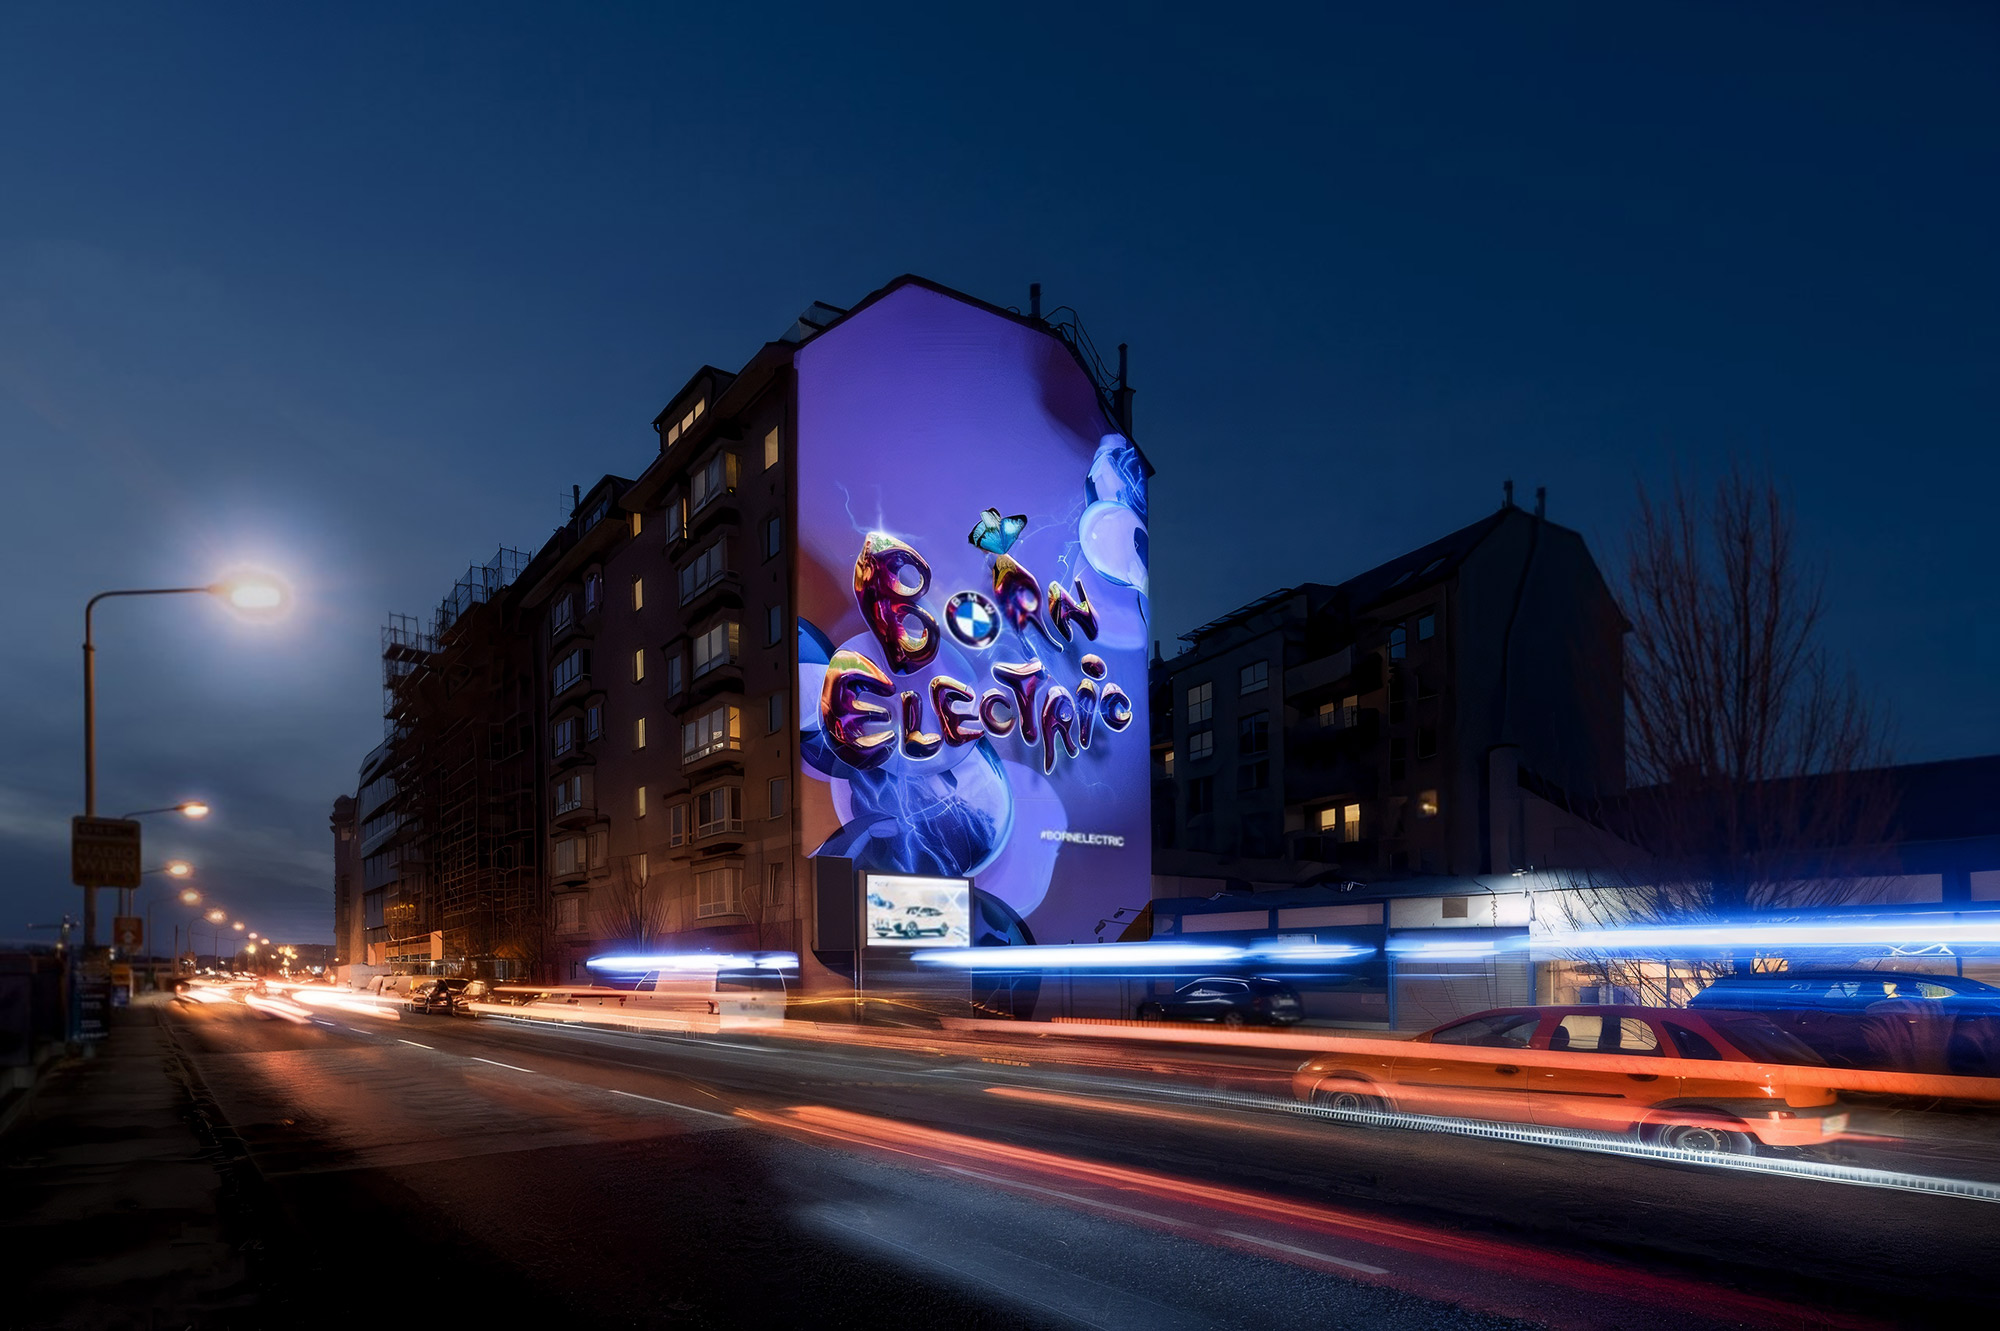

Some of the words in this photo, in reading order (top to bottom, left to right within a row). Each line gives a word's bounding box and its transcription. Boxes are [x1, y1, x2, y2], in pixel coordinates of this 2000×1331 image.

[1040, 830, 1125, 847] #BORNELECTRIC
[77, 843, 137, 859] RADIO
[77, 858, 137, 873] WIEN
